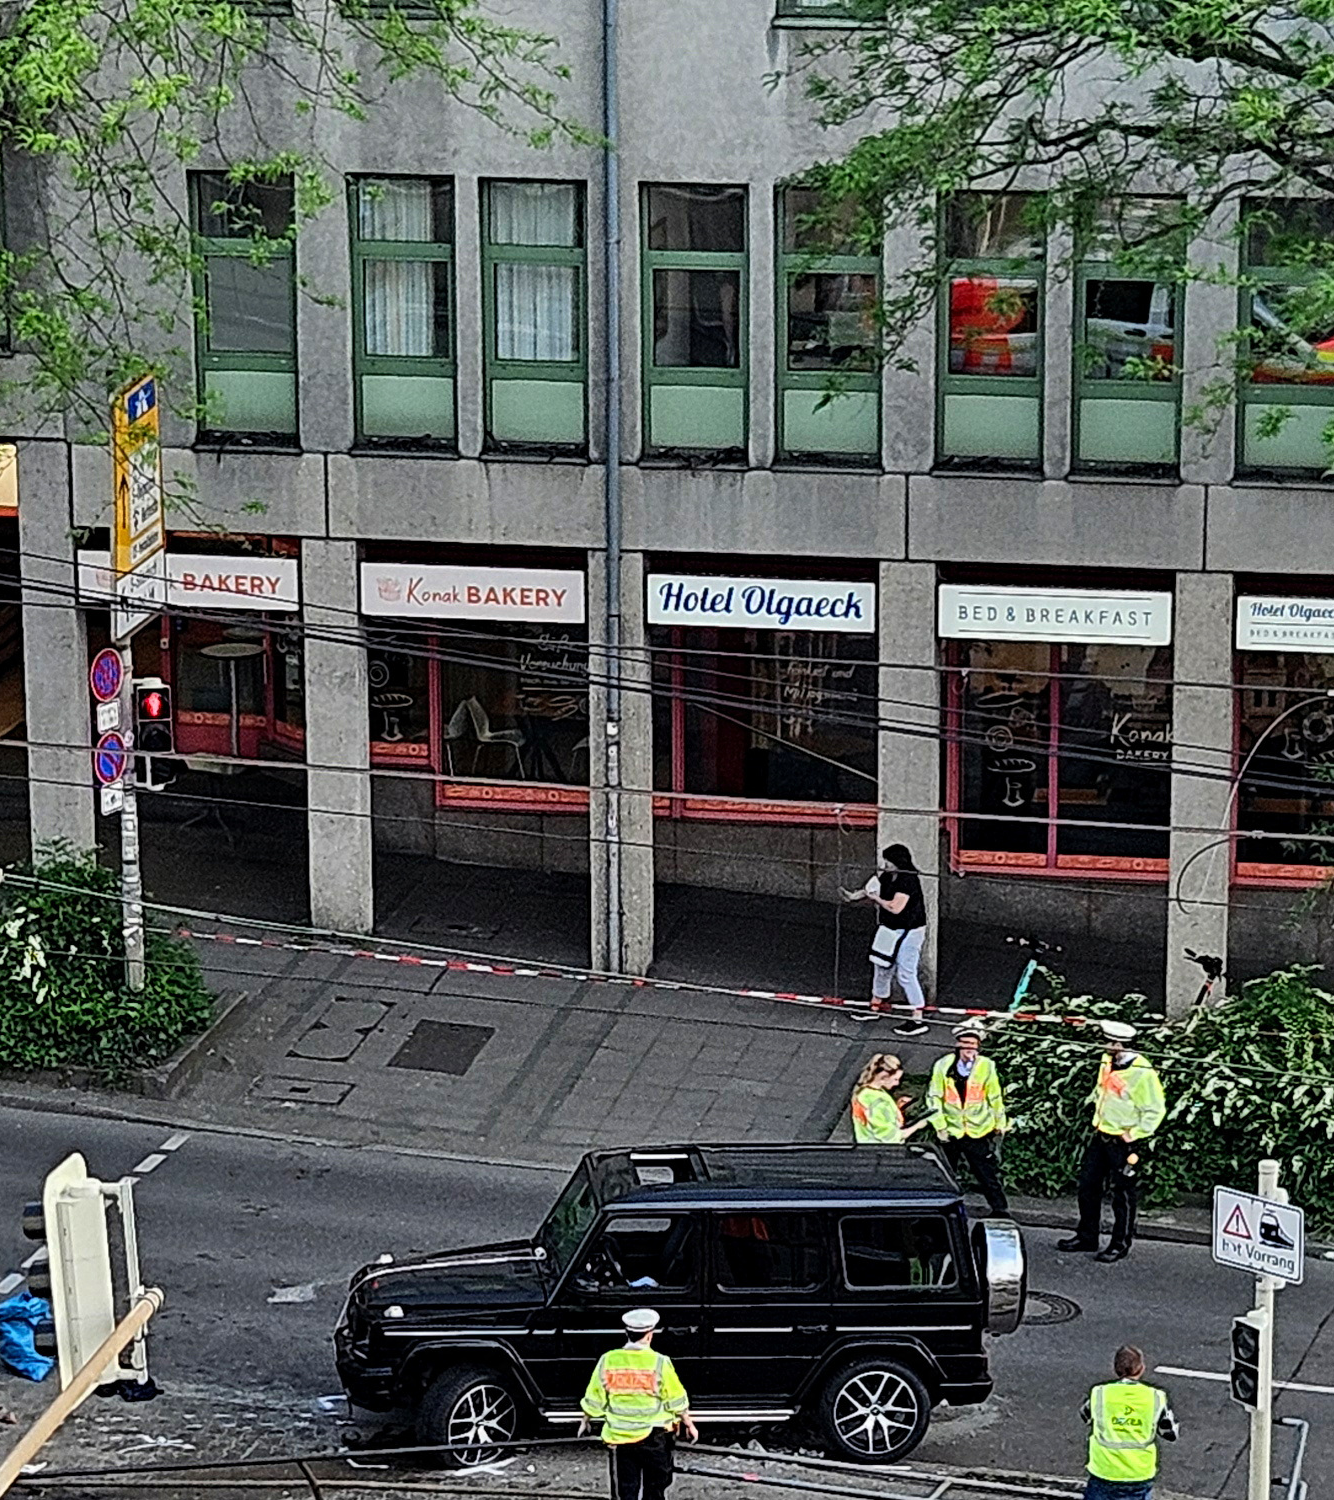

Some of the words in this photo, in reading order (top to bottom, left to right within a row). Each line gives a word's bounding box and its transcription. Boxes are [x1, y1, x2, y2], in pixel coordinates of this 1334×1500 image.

[182, 572, 281, 594] BAKERY
[406, 577, 461, 606] Konak
[466, 586, 567, 607] BAKERY
[659, 582, 735, 613] Hotel
[741, 585, 863, 625] Olgaeck
[958, 605, 998, 621] BED
[1006, 606, 1016, 622] &
[1025, 608, 1152, 626] BREAKFAST
[1250, 602, 1285, 617] Hotel
[1110, 713, 1175, 747] Konak
[1246, 1244, 1295, 1274] Vorrang
